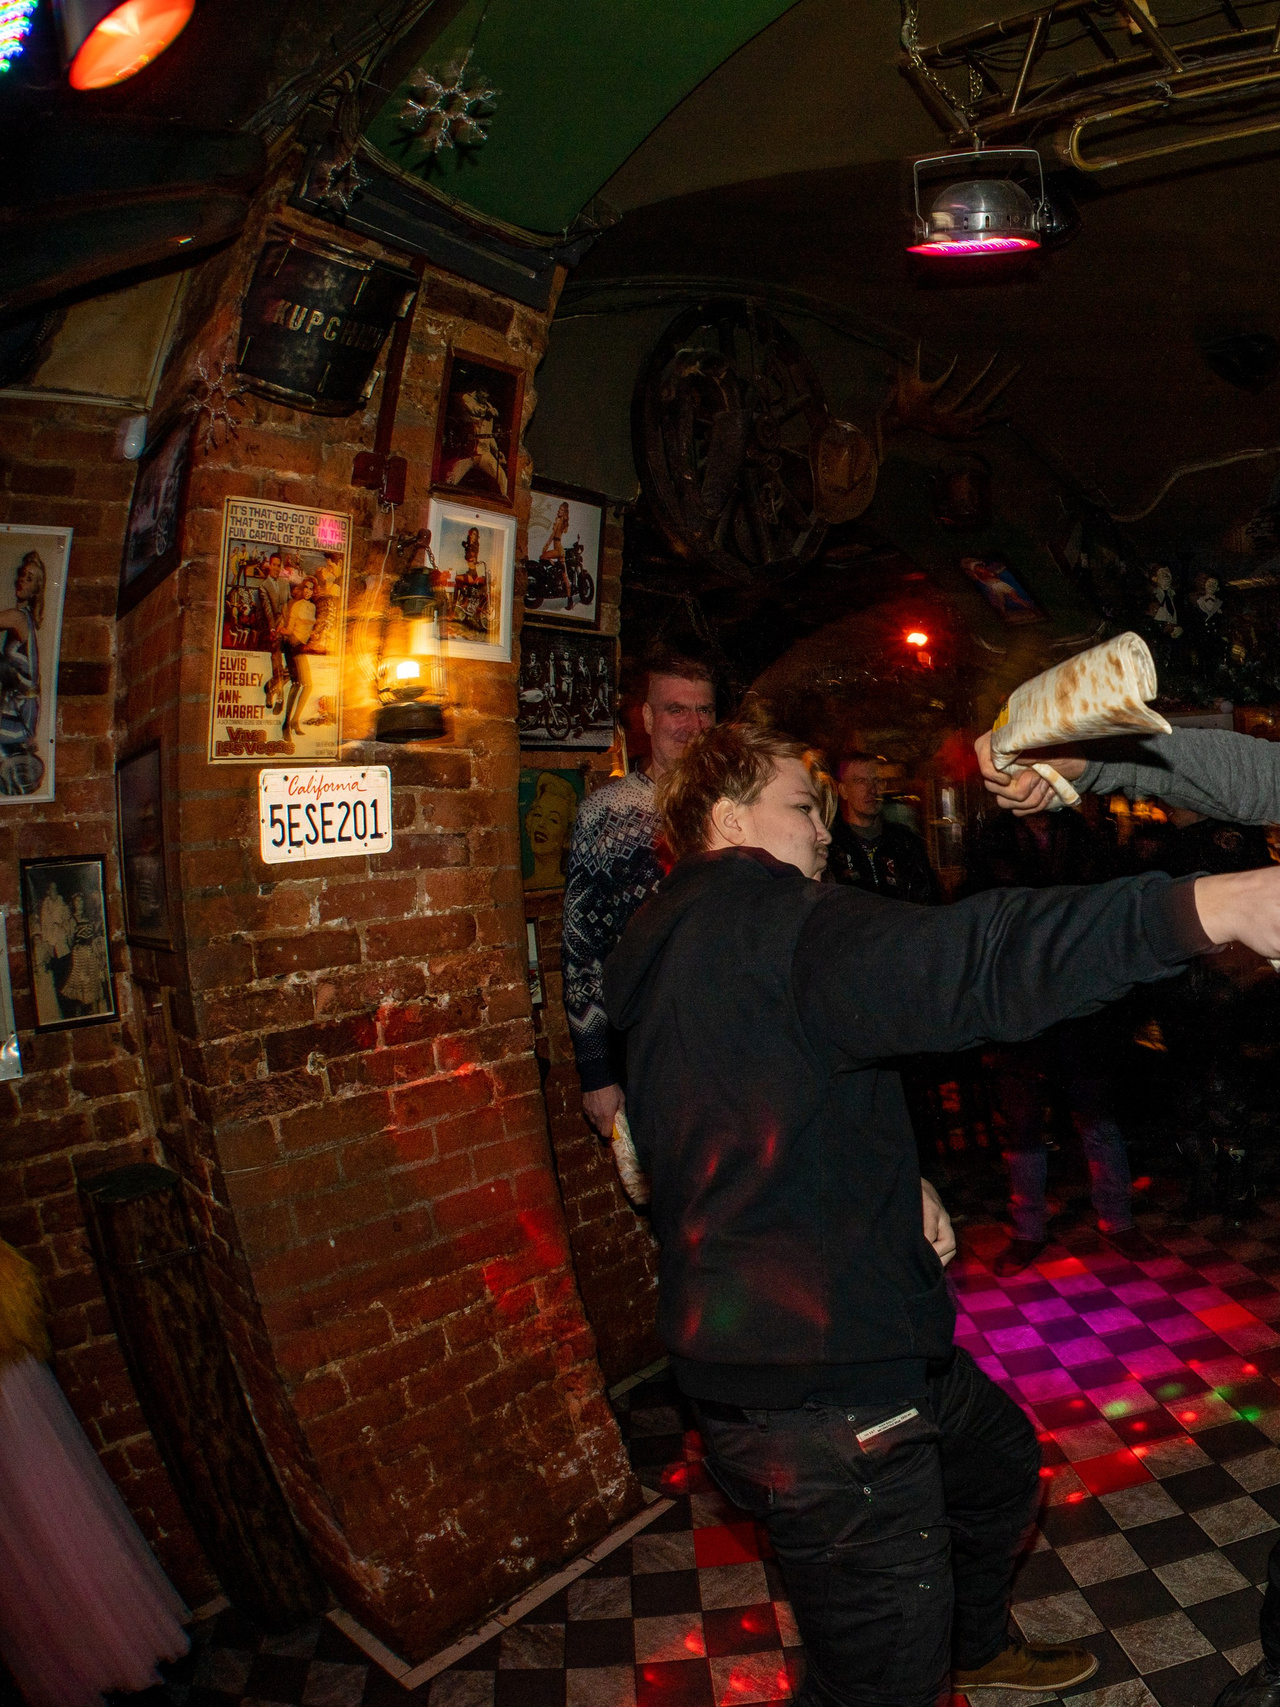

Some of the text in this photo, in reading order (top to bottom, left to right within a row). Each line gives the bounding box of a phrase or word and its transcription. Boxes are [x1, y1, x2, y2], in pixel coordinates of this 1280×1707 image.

[230, 505, 247, 516] IT'S
[249, 507, 272, 519] THAT
[308, 516, 327, 528] GUY
[328, 518, 347, 531] AND
[230, 516, 254, 528] THAT
[298, 525, 316, 537] GAL
[317, 528, 328, 539] IN
[330, 529, 347, 542] THE
[228, 526, 346, 551] FUN CAPITAL OF THE WORLD!
[220, 656, 247, 671] ELVIS
[218, 671, 263, 687] PRESLEY
[217, 689, 242, 704] ANN-
[216, 704, 266, 719] MARGRET
[225, 726, 268, 742] Viva
[244, 740, 296, 757] Vegas
[288, 774, 367, 801] California
[268, 798, 384, 848] 5ESE201
